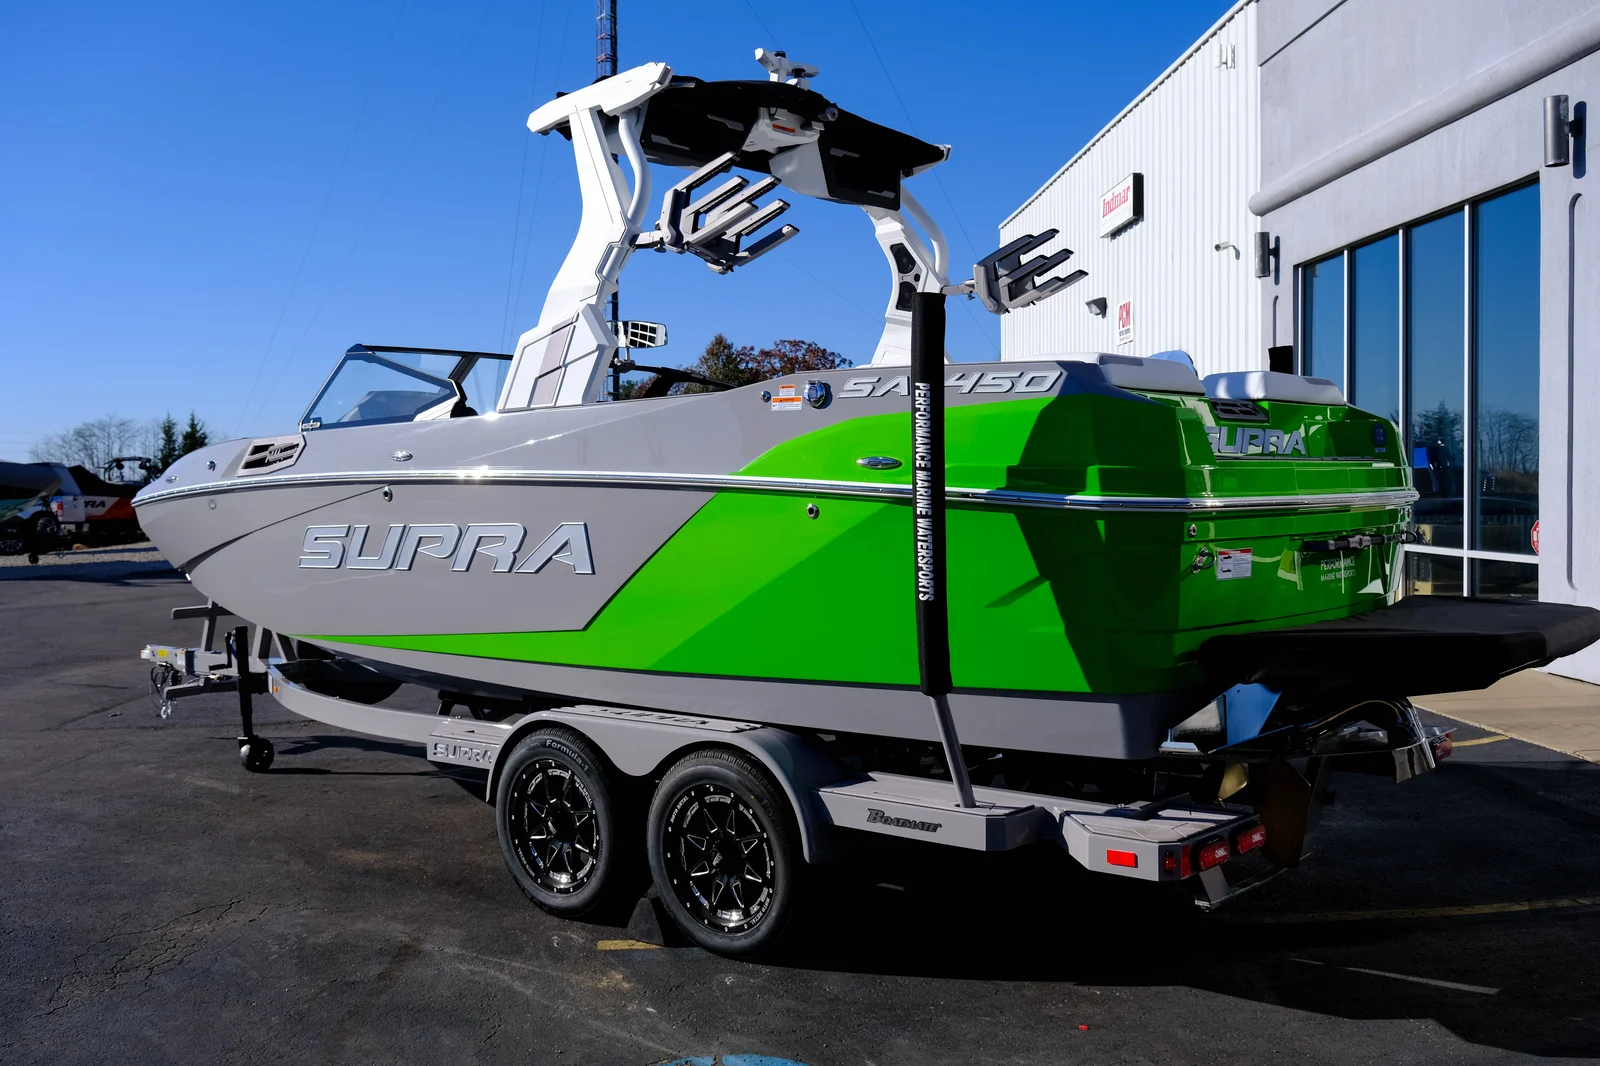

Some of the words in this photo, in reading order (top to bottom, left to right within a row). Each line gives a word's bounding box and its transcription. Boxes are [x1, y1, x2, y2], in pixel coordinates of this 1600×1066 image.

[1102, 185, 1130, 218] Indmar
[1118, 301, 1130, 330] PCM
[914, 382, 931, 468] PERFORMANCE
[915, 470, 931, 516] MARINE
[298, 522, 596, 575] SUPRA
[916, 518, 934, 601] WATERSPORTS
[433, 742, 493, 764] SUPRA
[546, 739, 589, 772] Formula-1
